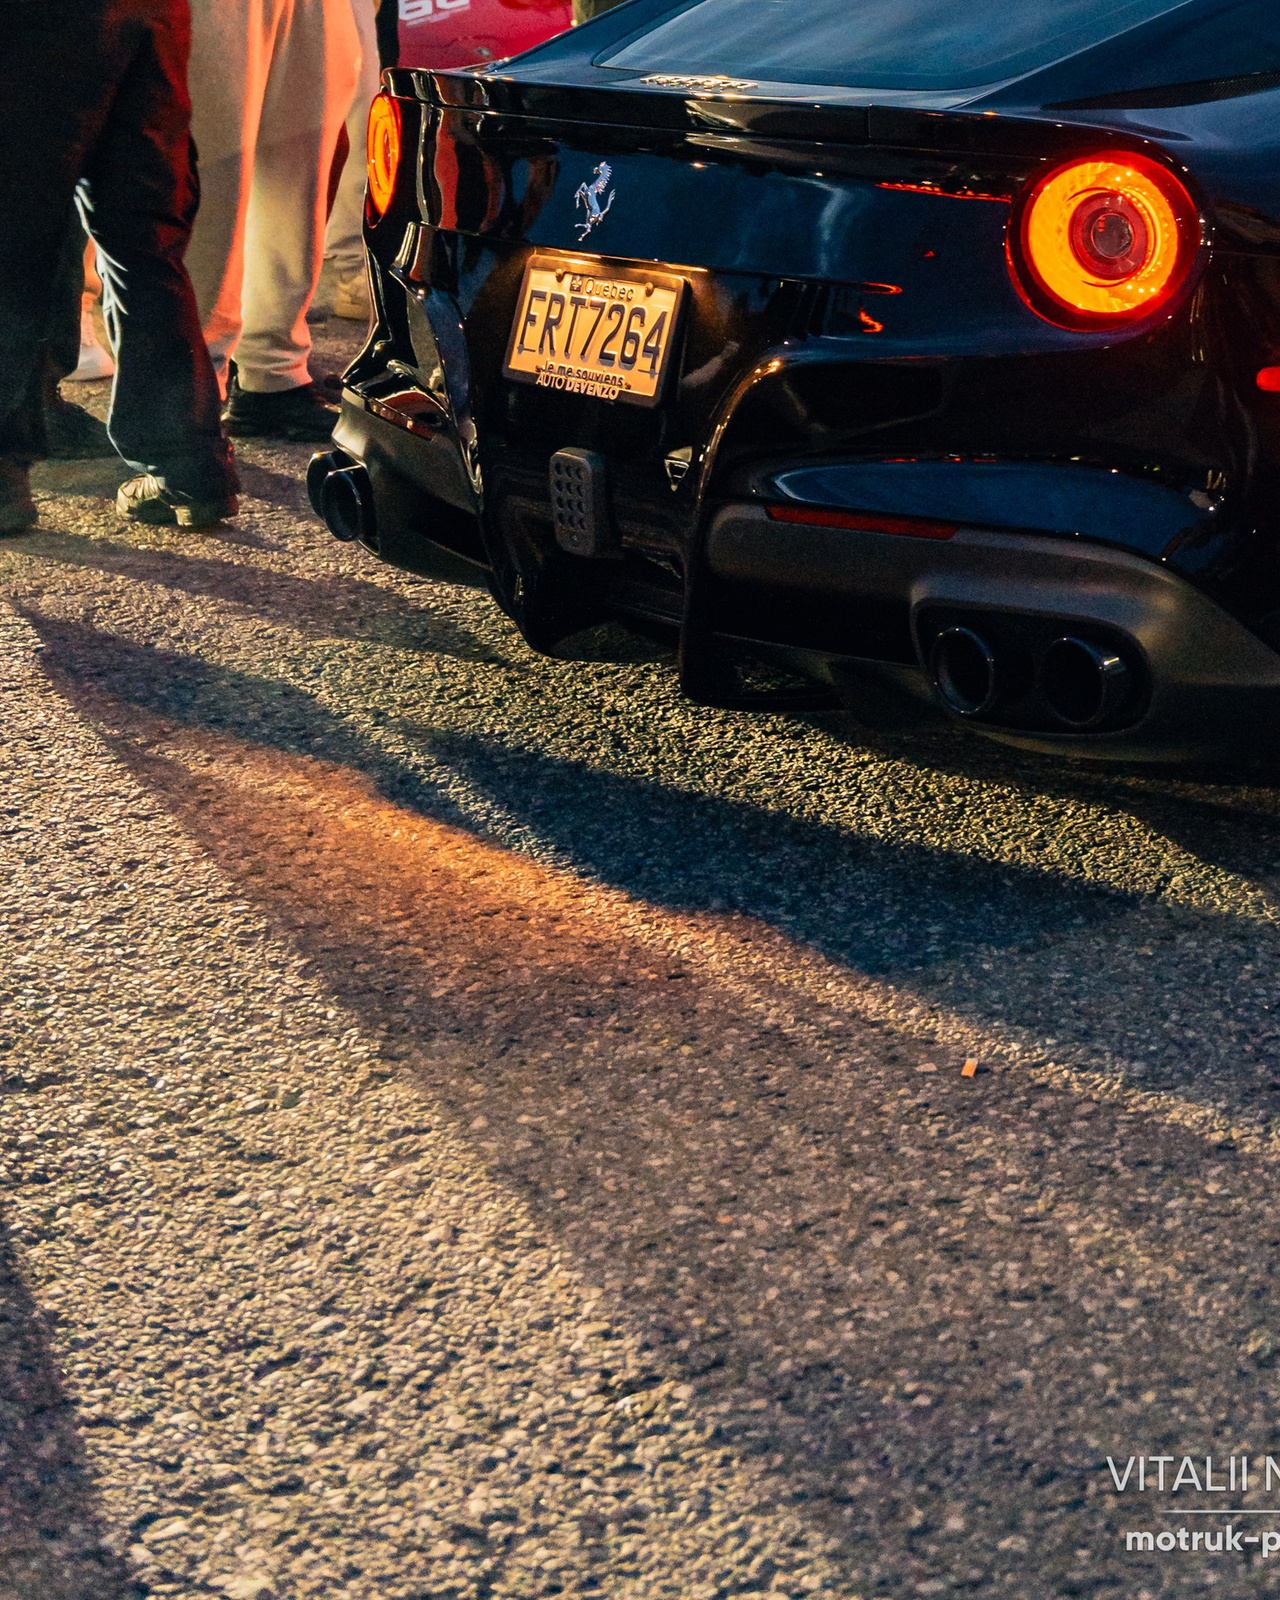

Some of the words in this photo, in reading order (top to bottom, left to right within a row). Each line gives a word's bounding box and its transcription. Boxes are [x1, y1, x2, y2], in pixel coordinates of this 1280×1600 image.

[517, 289, 668, 373] FRT7264
[535, 373, 565, 390] AUTO
[565, 380, 620, 400] DEVENZO
[557, 364, 572, 377] me
[576, 366, 625, 388] souviens
